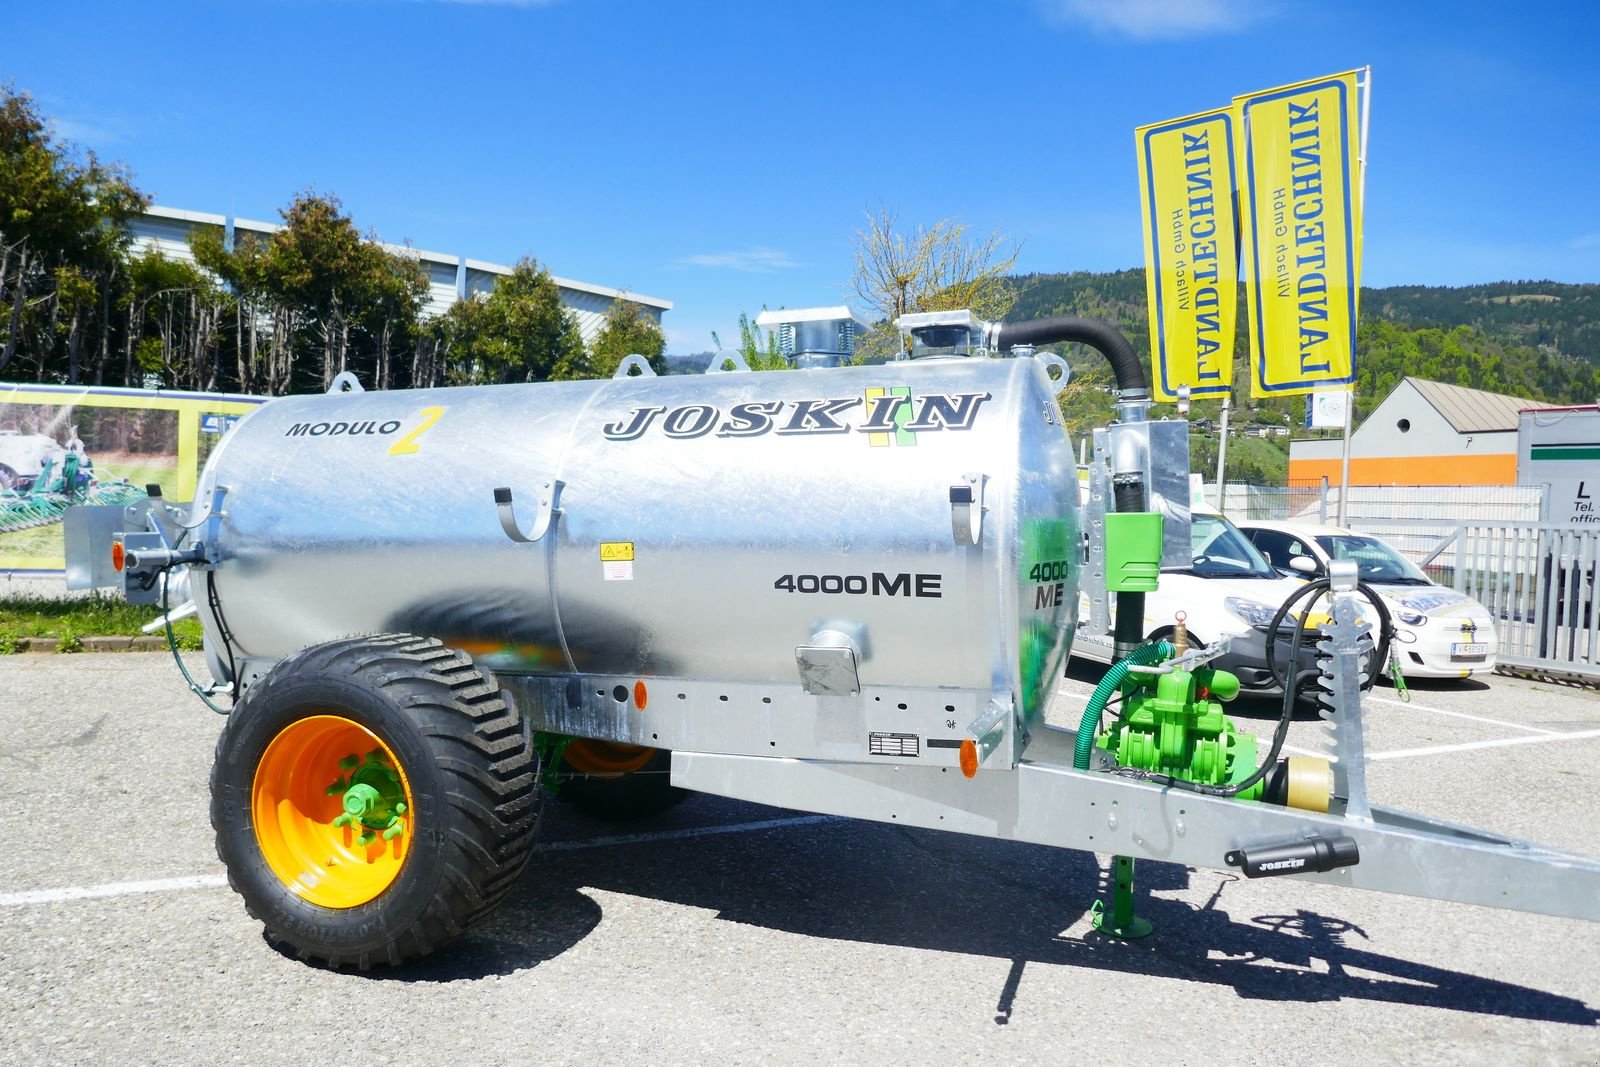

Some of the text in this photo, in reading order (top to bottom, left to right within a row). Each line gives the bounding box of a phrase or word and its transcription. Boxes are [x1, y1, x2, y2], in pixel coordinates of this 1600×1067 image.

[601, 392, 992, 441] JOSKIN
[285, 406, 445, 456] MODULO 2
[1574, 501, 1595, 512] Tel.
[1028, 560, 1069, 583] 4000
[1034, 582, 1065, 610] ME
[1258, 858, 1306, 871] JOSKIN
